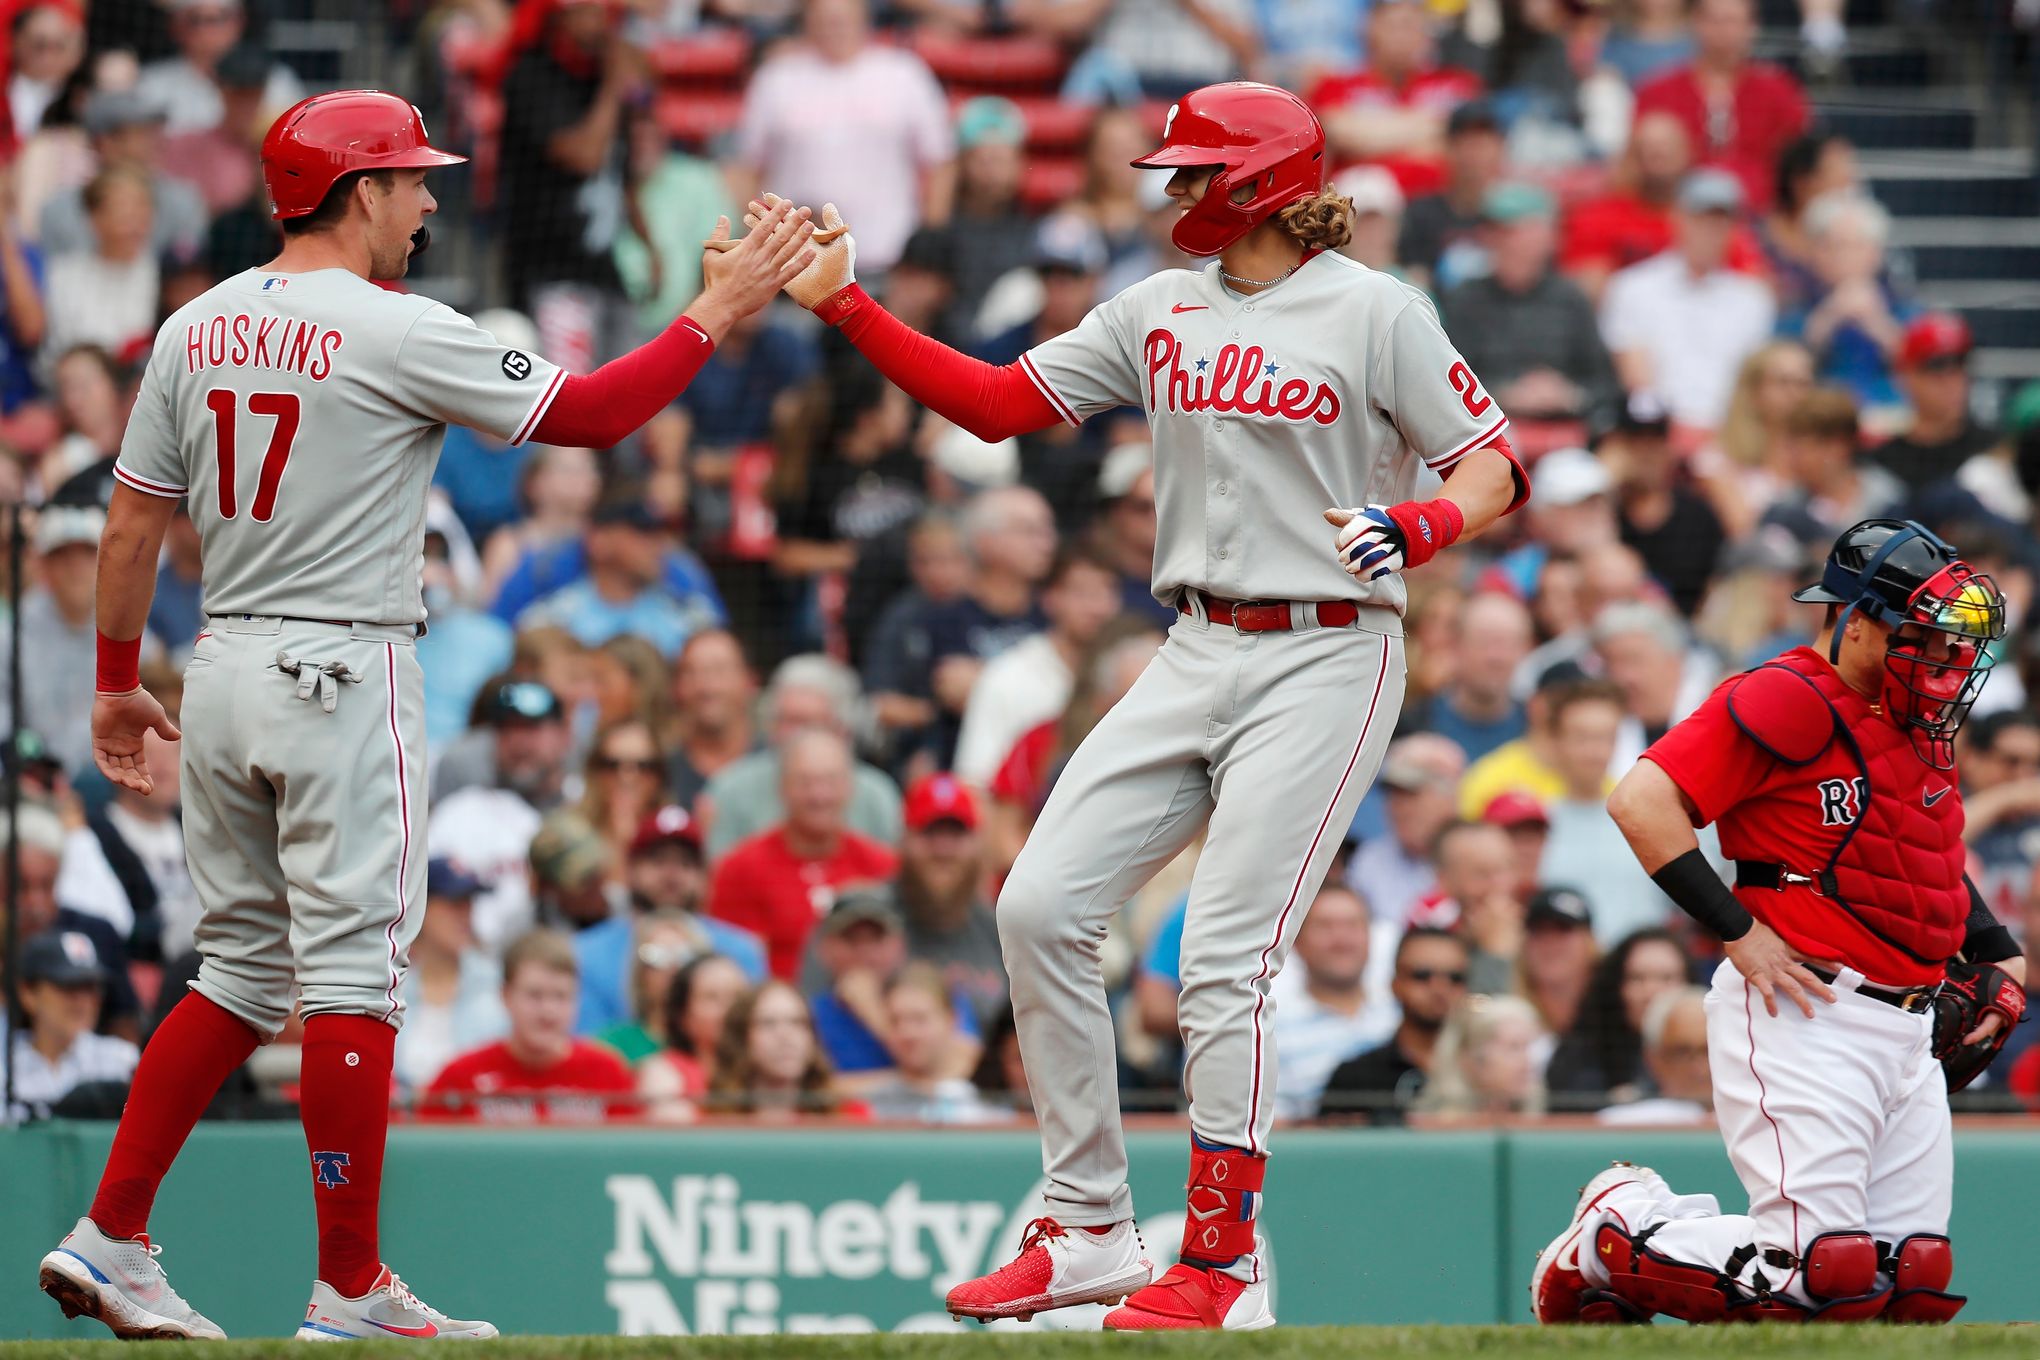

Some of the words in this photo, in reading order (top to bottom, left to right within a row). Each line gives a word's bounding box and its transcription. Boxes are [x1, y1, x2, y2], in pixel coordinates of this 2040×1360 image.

[186, 313, 343, 383] HOSKINS
[503, 351, 529, 379] 15
[1143, 326, 1342, 428] Phillies
[206, 387, 303, 524] 17
[604, 1173, 1001, 1298] Ninety
